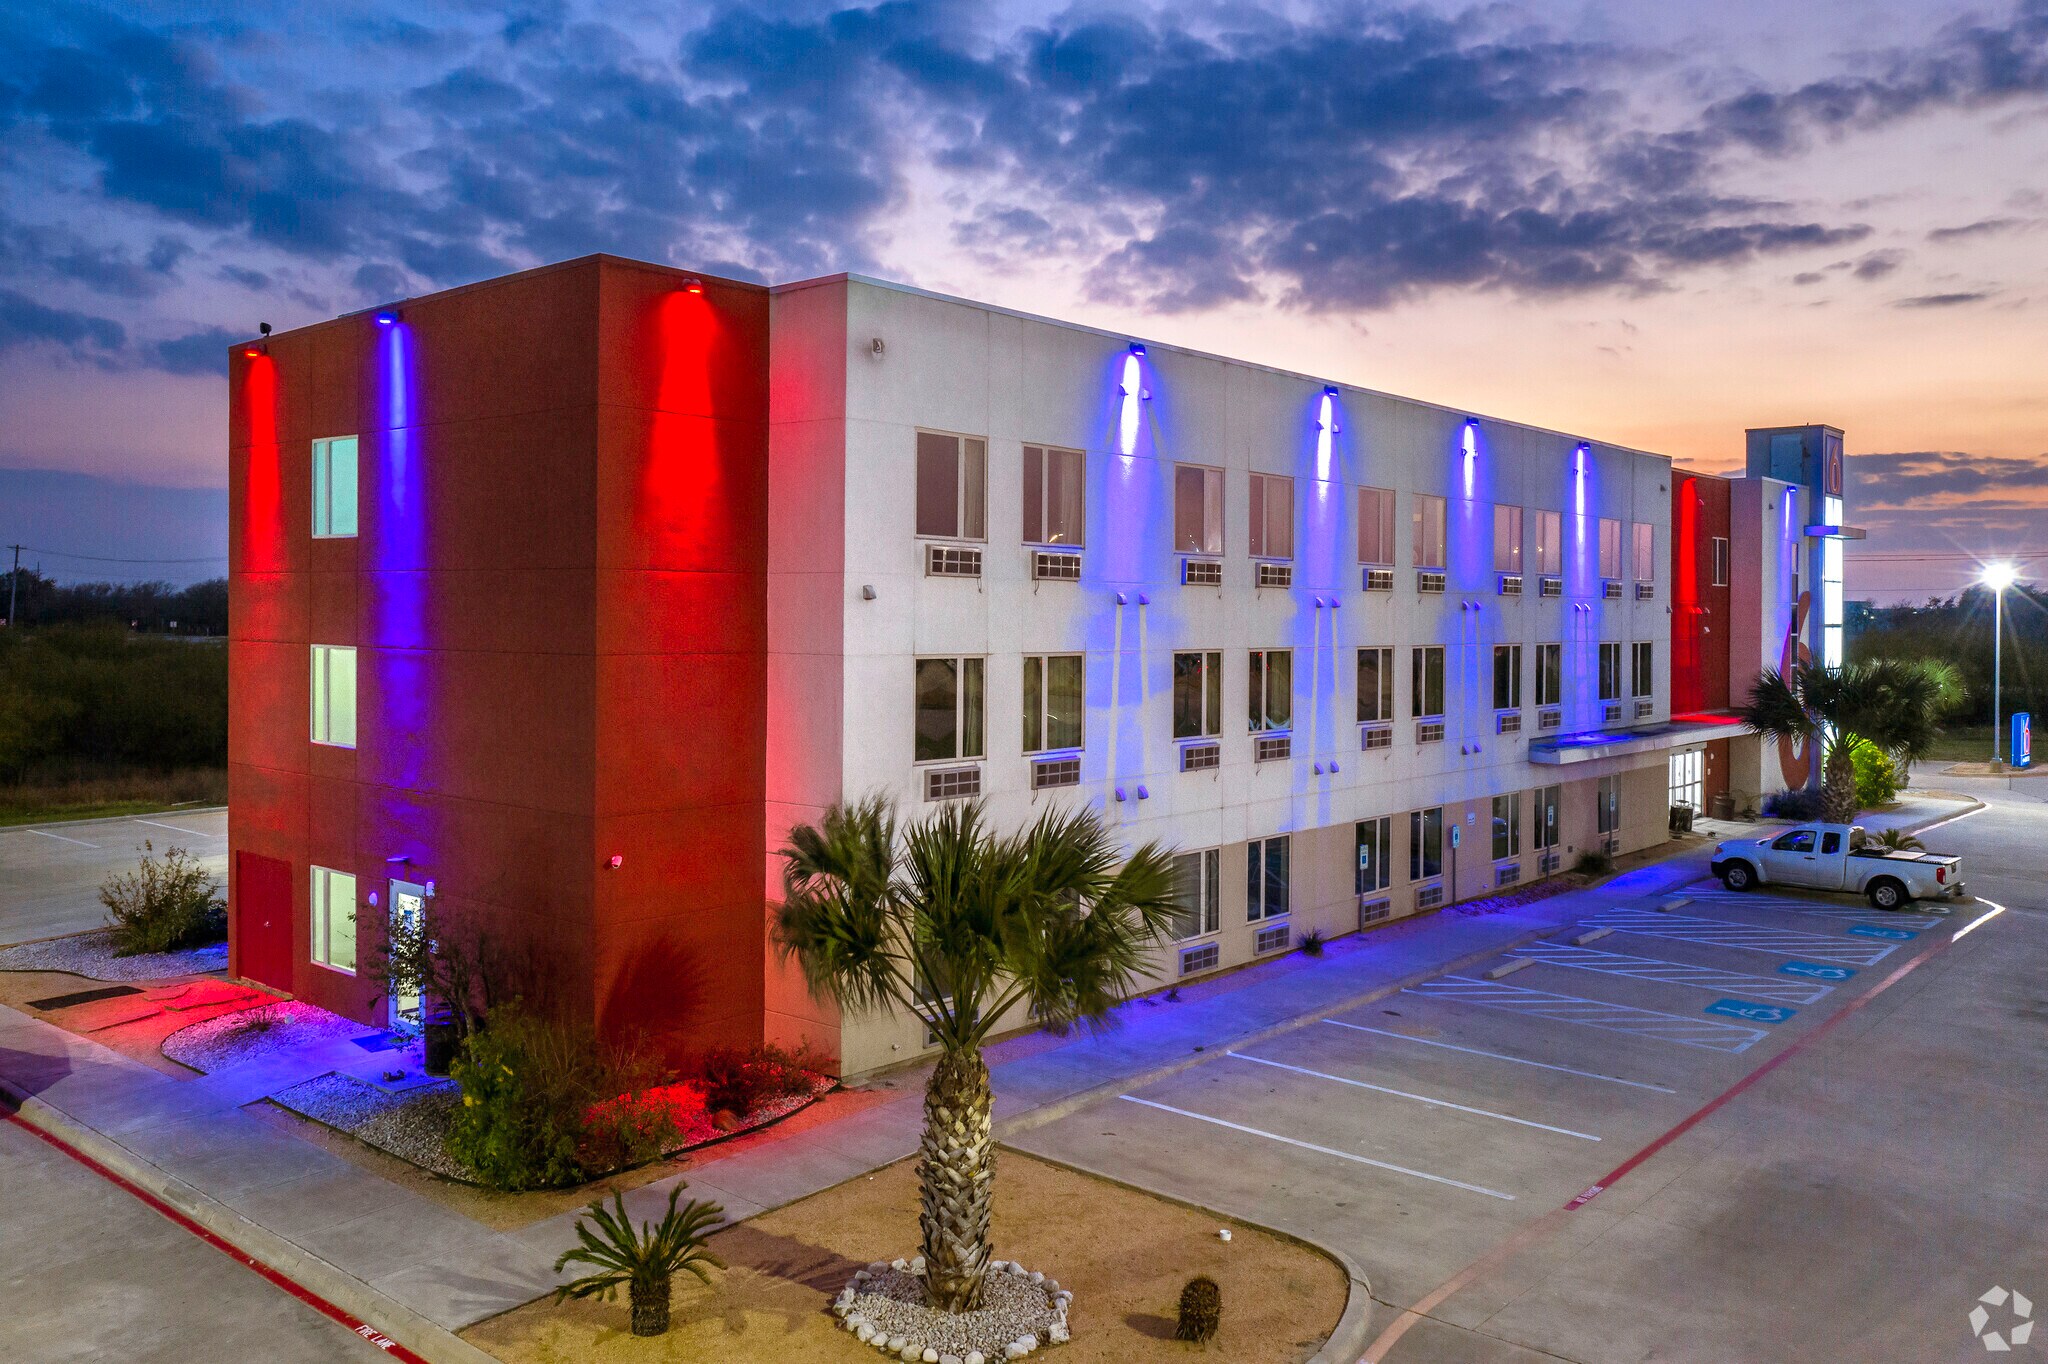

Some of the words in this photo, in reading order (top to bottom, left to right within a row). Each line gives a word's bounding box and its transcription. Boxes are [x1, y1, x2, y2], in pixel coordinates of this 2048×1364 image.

[1830, 441, 1841, 494] 6
[2024, 717, 2030, 755] 6
[355, 1324, 378, 1338] FIRE
[370, 1335, 396, 1350] LANE
